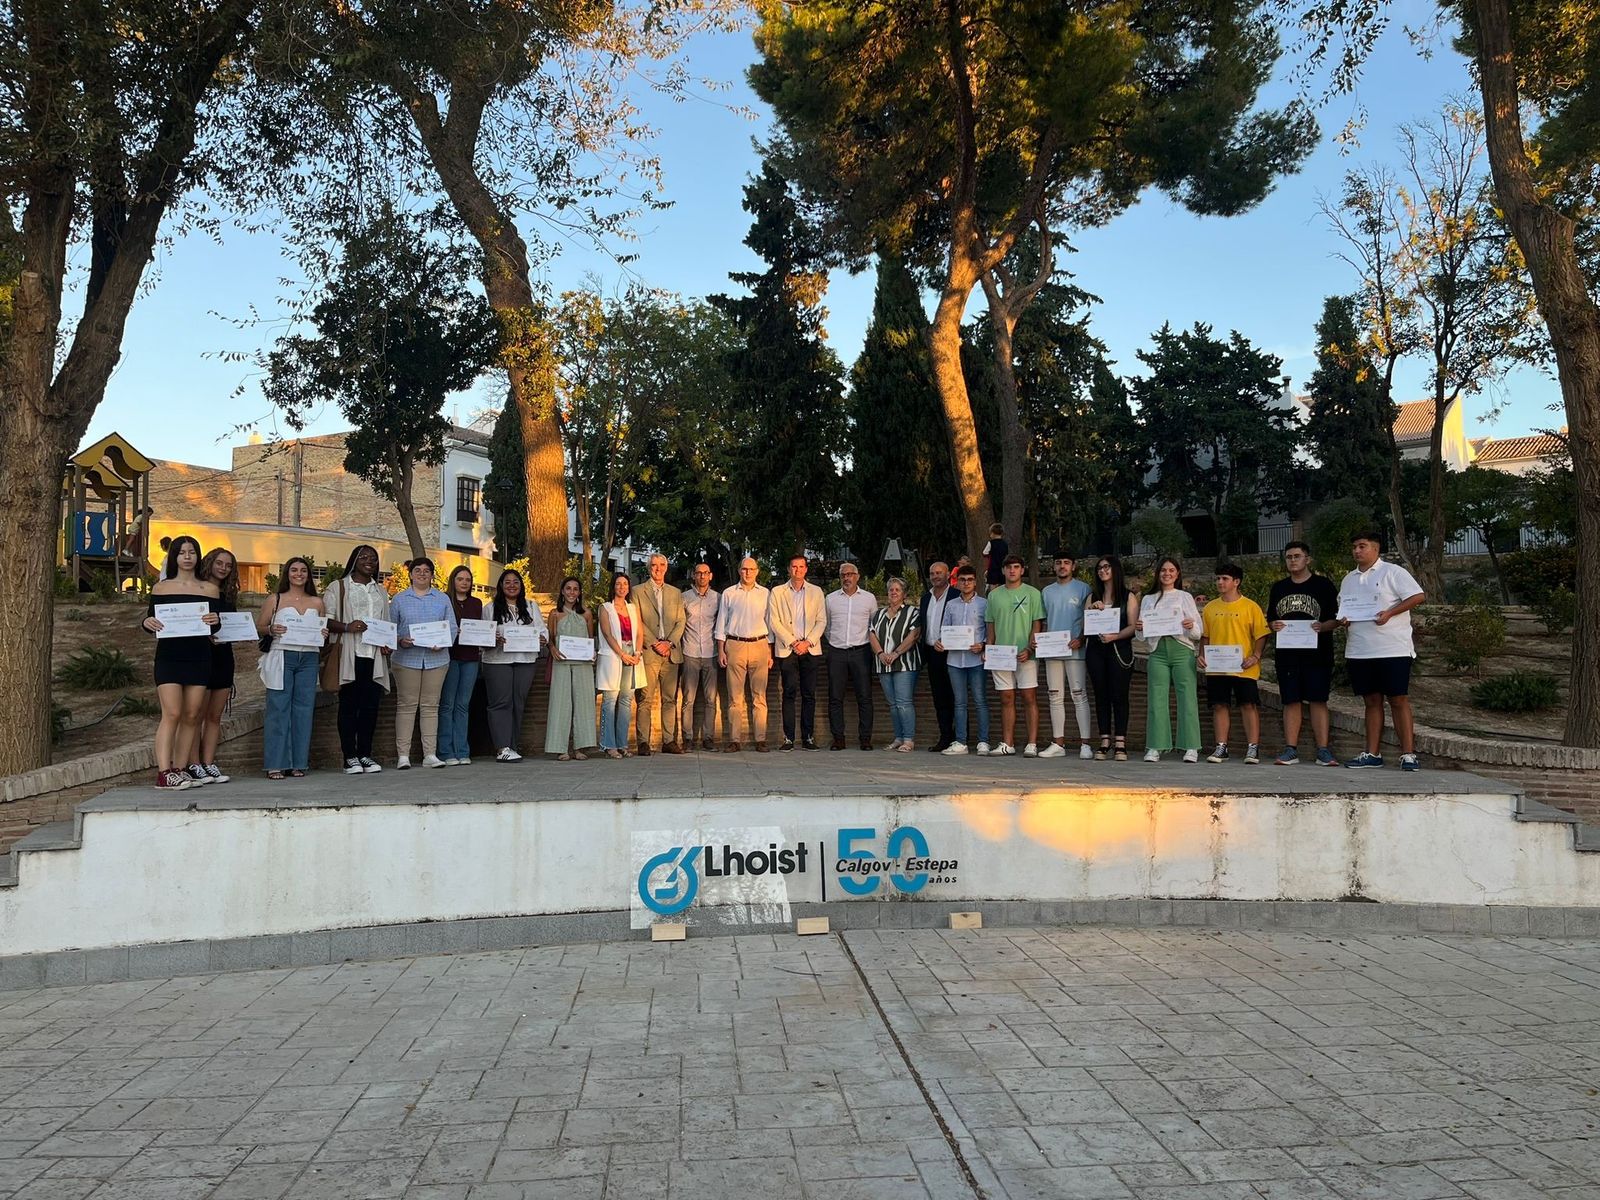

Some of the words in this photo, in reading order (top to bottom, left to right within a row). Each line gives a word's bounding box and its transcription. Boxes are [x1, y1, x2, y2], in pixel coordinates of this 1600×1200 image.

[705, 842, 808, 877] Lhoist
[835, 858, 891, 875] Calgov
[905, 857, 958, 873] Estepa
[838, 826, 930, 895] 50
[928, 875, 957, 883] años
